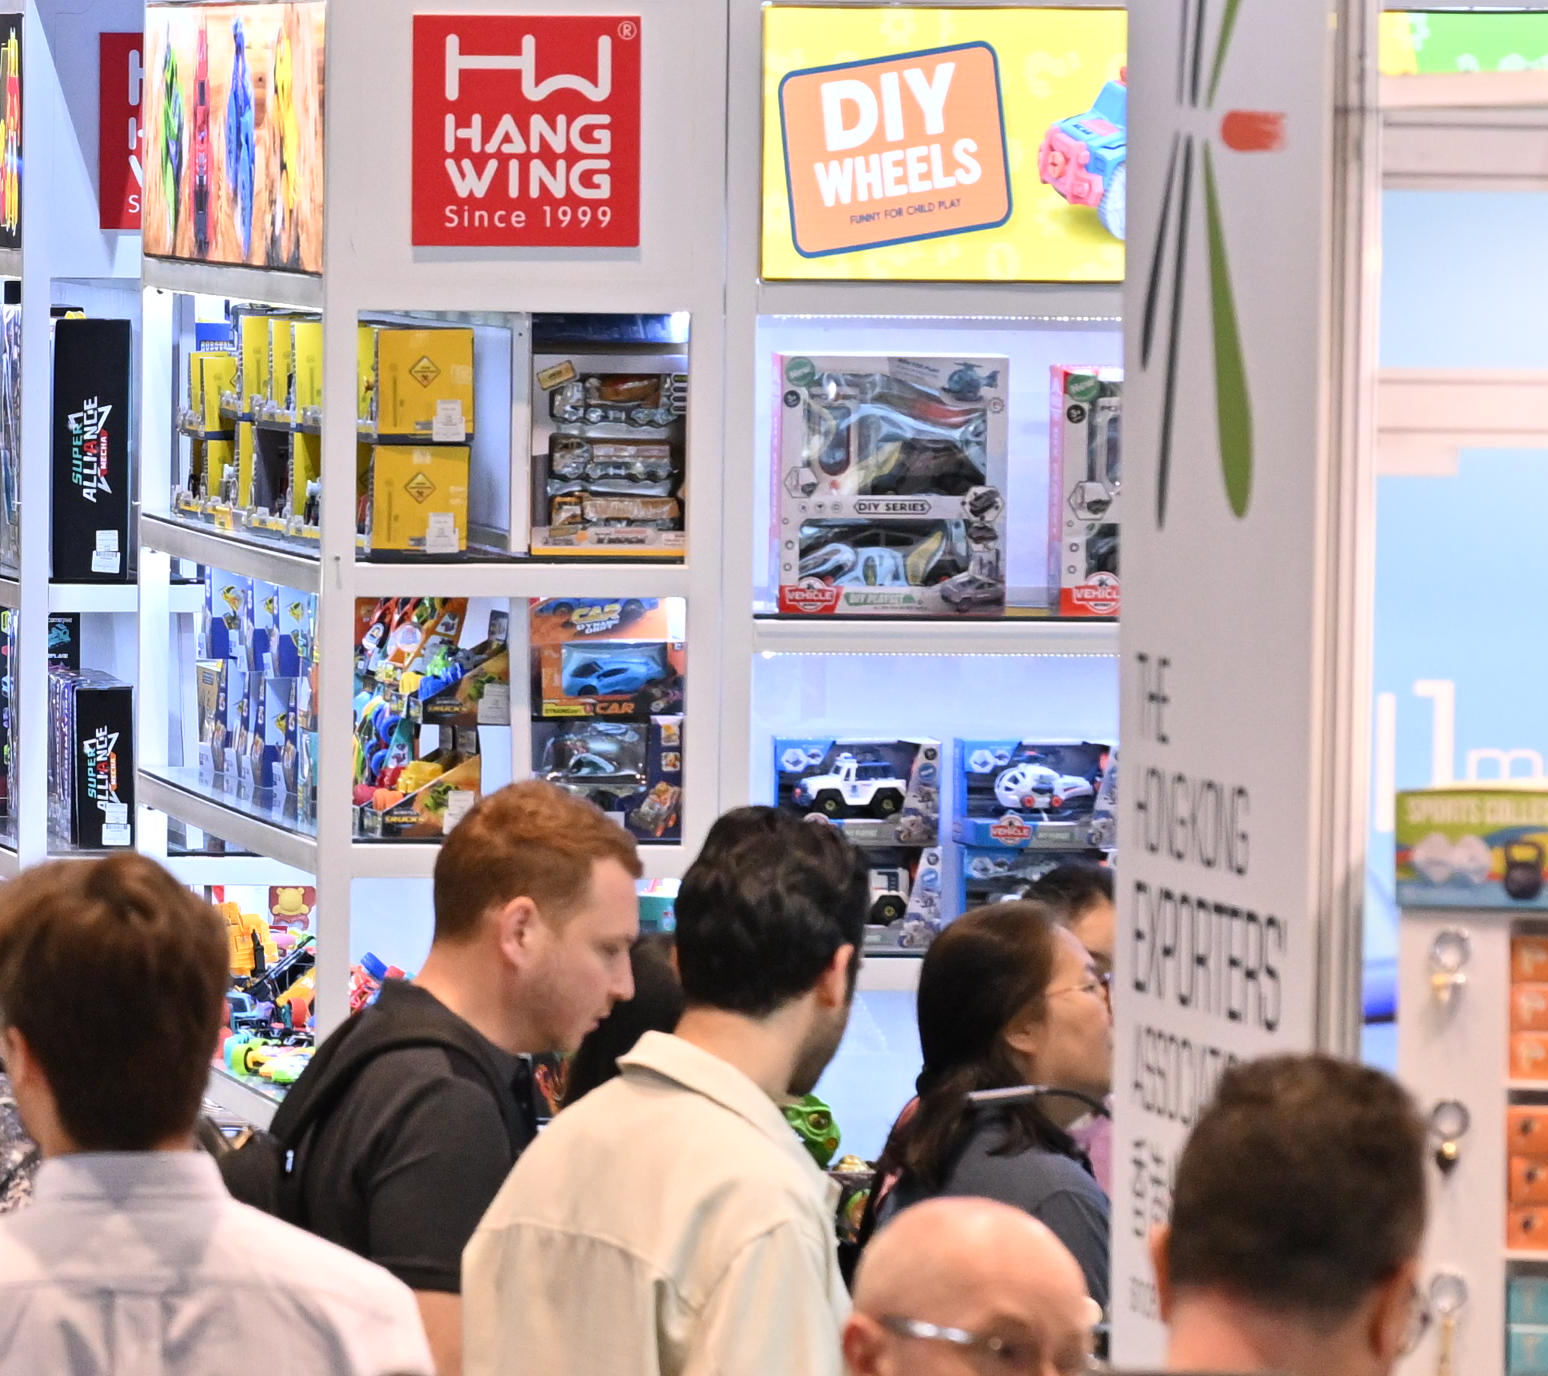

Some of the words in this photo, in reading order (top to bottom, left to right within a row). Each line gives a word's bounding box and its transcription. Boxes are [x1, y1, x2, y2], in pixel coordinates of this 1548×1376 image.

[820, 61, 956, 152] DIY
[444, 112, 612, 155] HANG
[444, 157, 612, 200] WING
[813, 137, 982, 207] WHEELS
[444, 205, 526, 228] Since
[542, 205, 612, 228] 1999
[850, 212, 881, 225] FUNNY
[884, 208, 904, 219] FOR
[906, 203, 935, 216] CHILD
[938, 198, 962, 210] PLAY
[72, 422, 84, 486] SUPER
[83, 396, 98, 503] ALLIANCE
[100, 434, 108, 470] MECHA
[858, 502, 882, 512] DIY
[885, 502, 926, 512] SERIES
[785, 590, 834, 603] VEHICLE
[1074, 589, 1121, 603] VEHICL
[571, 604, 622, 624] CAR
[595, 702, 635, 715] CAR
[87, 747, 98, 799] SUPER
[1408, 798, 1481, 824] SPORTS
[990, 827, 1031, 837] VEHICLE
